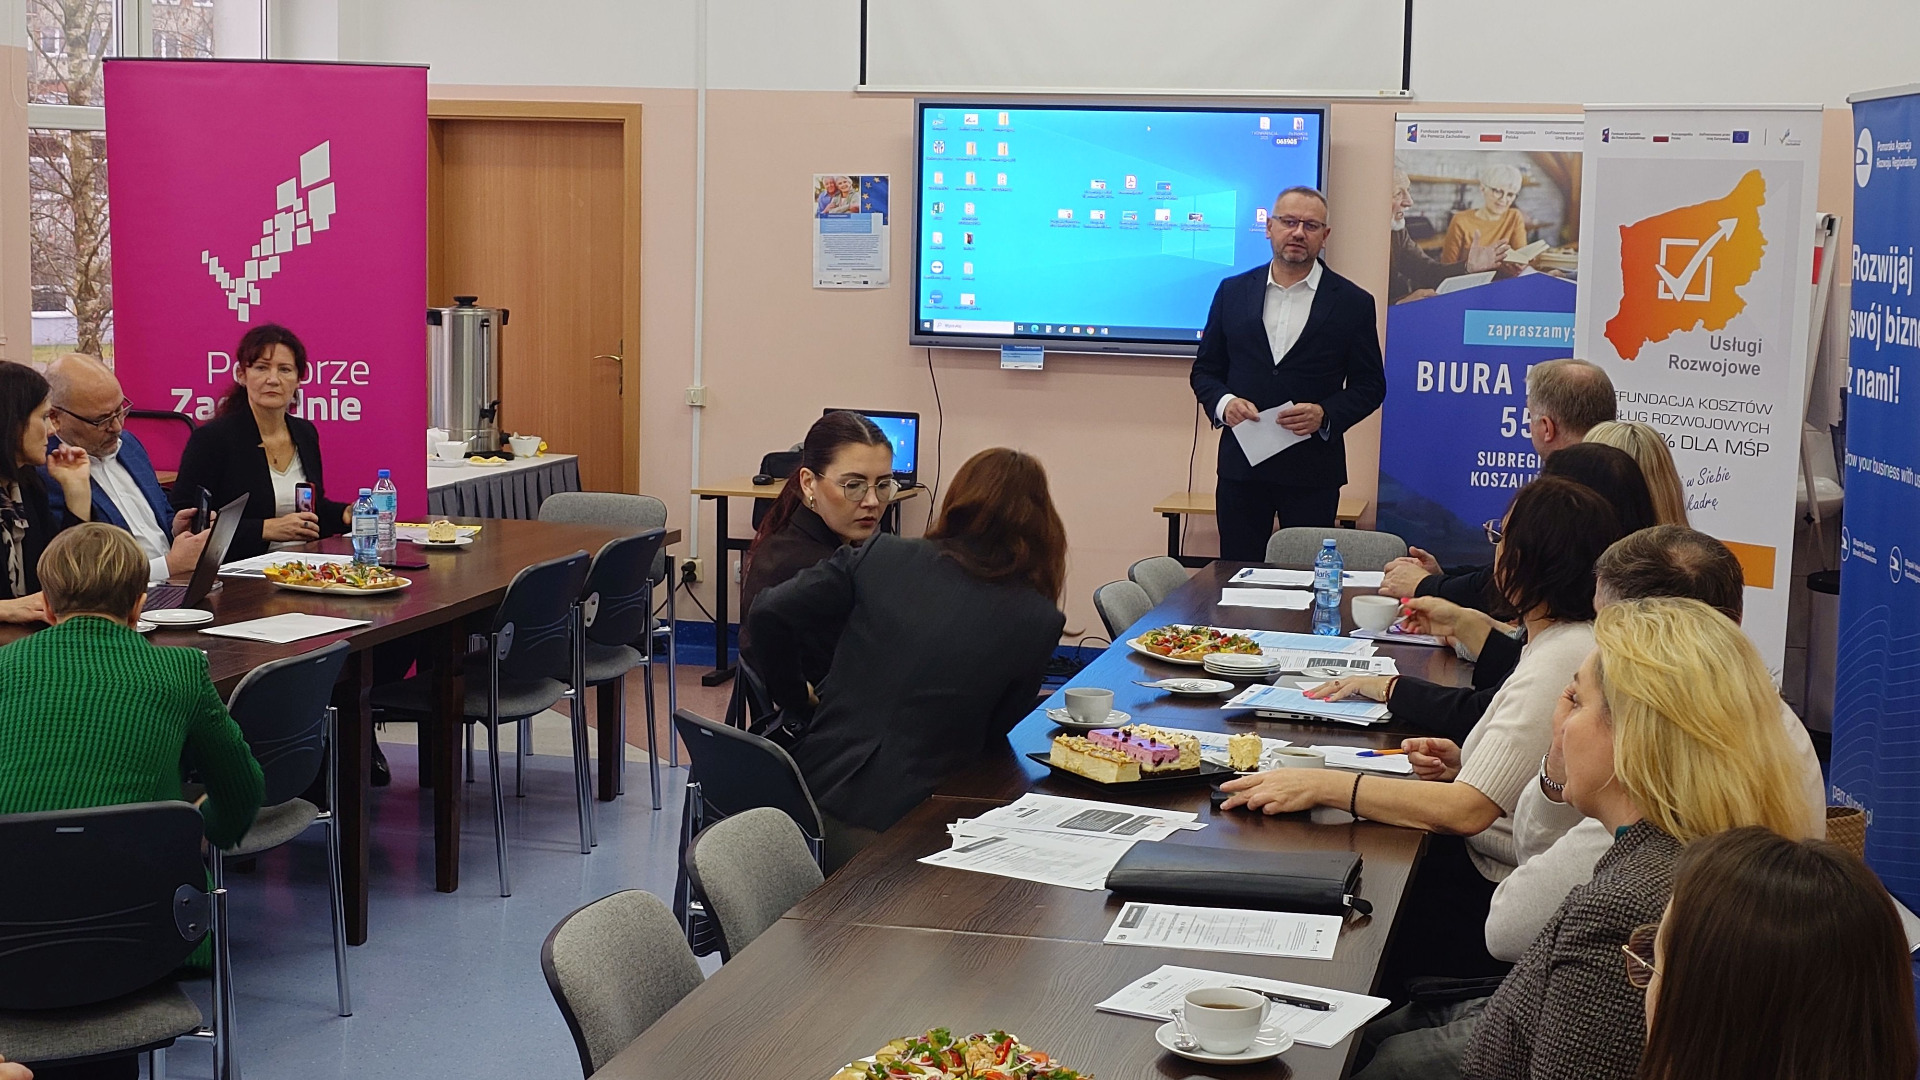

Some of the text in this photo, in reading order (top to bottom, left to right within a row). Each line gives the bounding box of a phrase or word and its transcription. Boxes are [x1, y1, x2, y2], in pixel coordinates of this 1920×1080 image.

[1852, 244, 1914, 296] Rozwijaj
[1850, 302, 1881, 352] swój
[1710, 335, 1763, 357] Usługi
[1669, 354, 1761, 377] Rozwojowe
[1417, 361, 1513, 395] BIURA
[1857, 366, 1900, 404] nami!
[1698, 397, 1774, 416] KOSZTÓW
[1651, 412, 1770, 435] ROZWOJOWYCH
[1680, 434, 1719, 453] DLA
[1725, 438, 1770, 457] MŚP
[1697, 465, 1731, 486] Siebie
[1858, 456, 1873, 473] your
[1873, 456, 1900, 480] business
[1901, 466, 1914, 485] with
